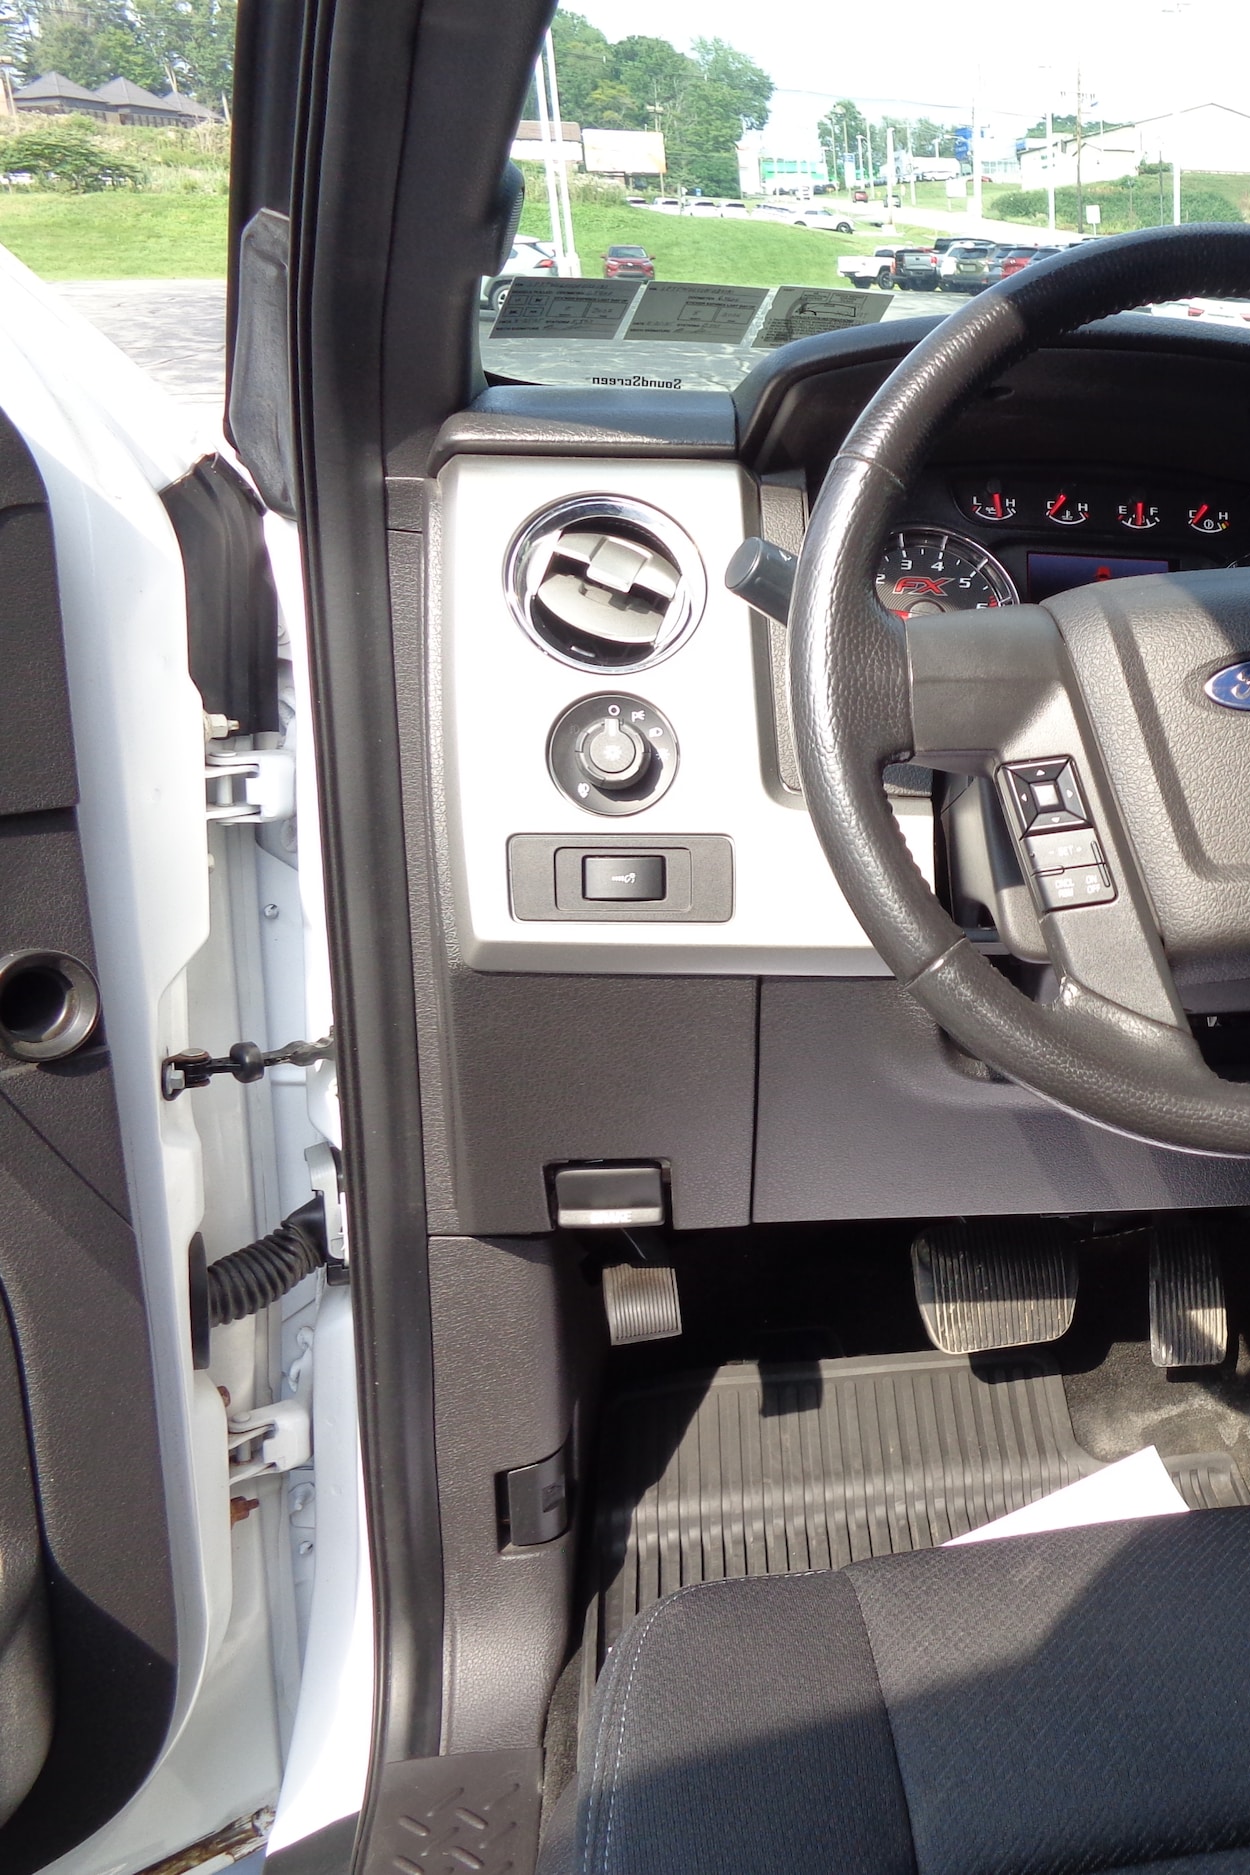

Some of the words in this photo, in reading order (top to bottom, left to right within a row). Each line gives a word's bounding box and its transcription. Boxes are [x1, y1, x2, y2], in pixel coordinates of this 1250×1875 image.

[972, 496, 982, 505] L
[1005, 498, 1016, 507] H
[1078, 503, 1088, 512] H
[1118, 505, 1127, 514] E
[1149, 507, 1159, 516] F
[1218, 512, 1229, 520] H
[901, 560, 913, 570] 3
[930, 561, 945, 571] 4
[876, 573, 886, 584] 2
[959, 578, 971, 589] 5
[892, 575, 956, 597] FX
[1058, 845, 1073, 856] SET
[1085, 874, 1098, 885] ON
[1086, 883, 1101, 894] OFF
